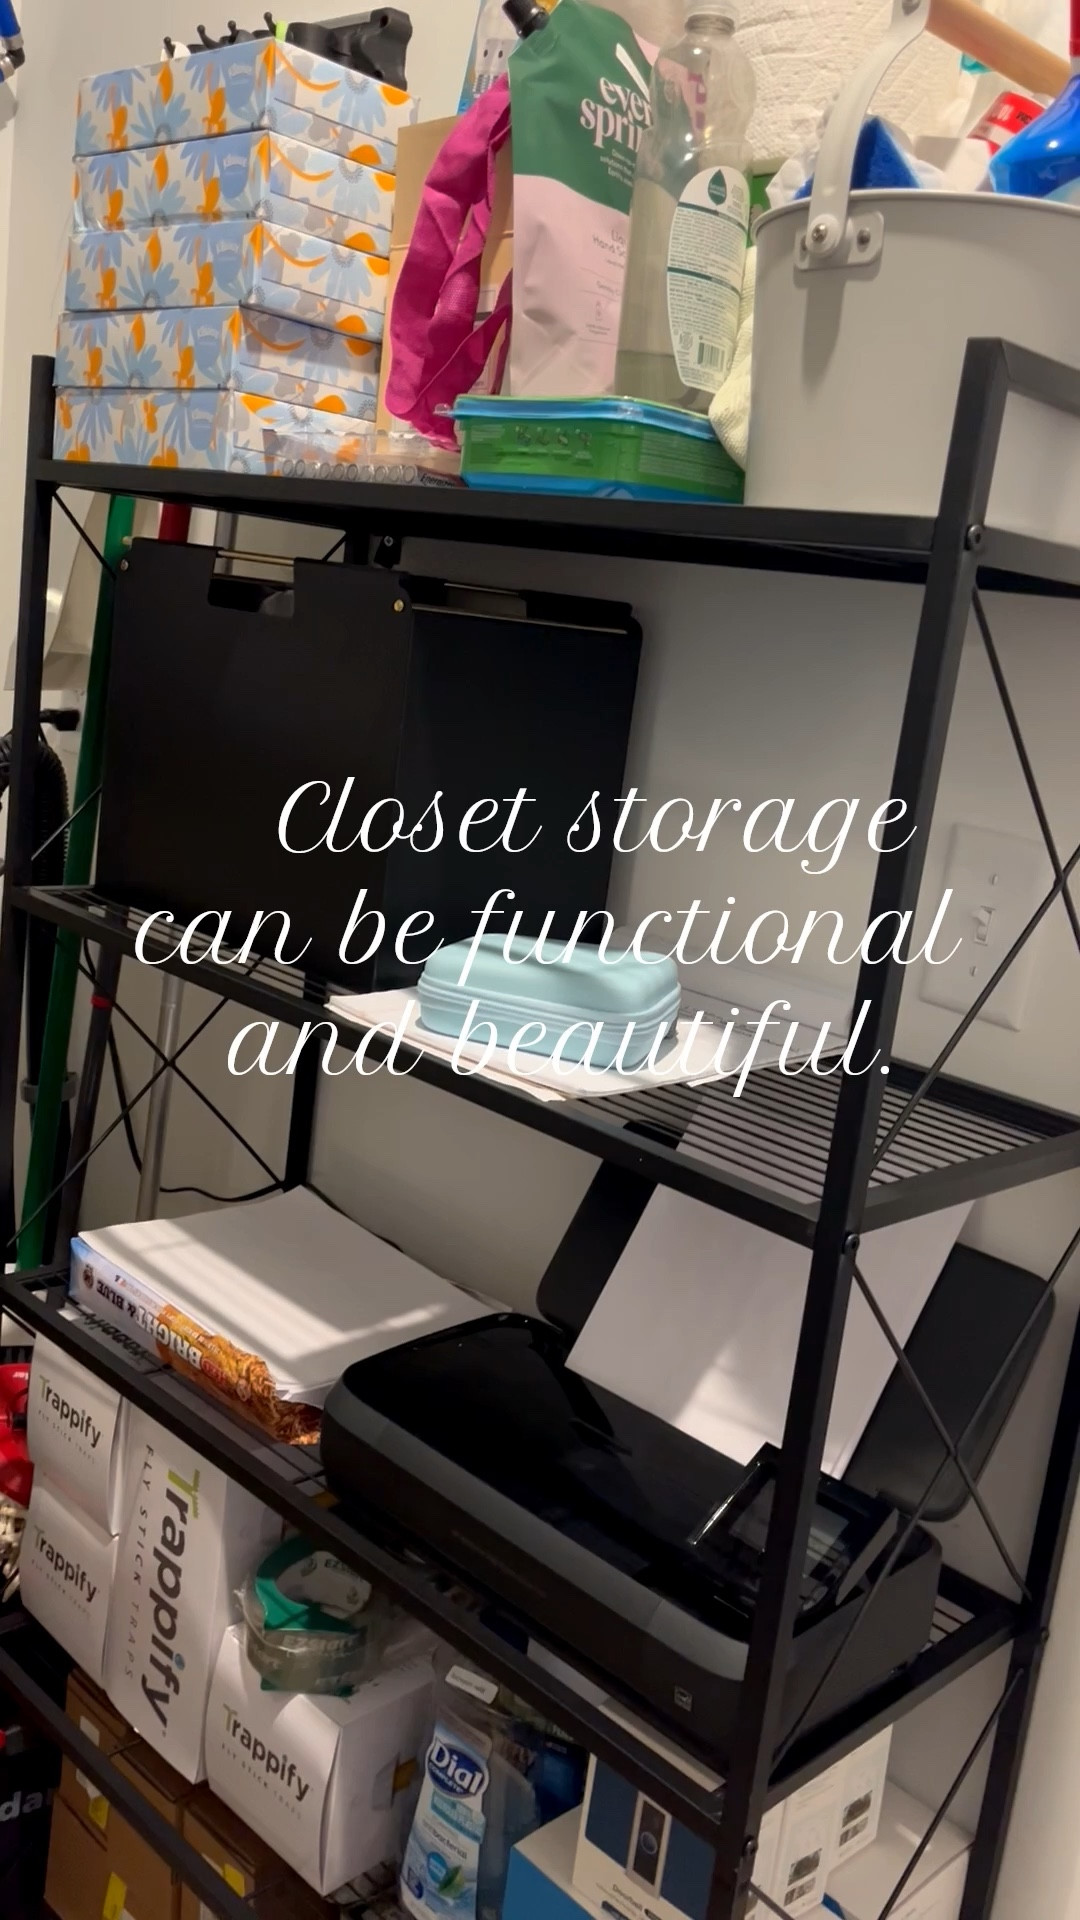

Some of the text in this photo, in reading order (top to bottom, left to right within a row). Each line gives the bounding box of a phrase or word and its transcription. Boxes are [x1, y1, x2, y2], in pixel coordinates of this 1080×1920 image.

[96, 1280, 125, 1311] BLUE
[127, 1302, 137, 1318] &
[136, 1305, 203, 1370] BRIGHT
[39, 1374, 102, 1449] Trappify
[33, 1524, 97, 1603] Trappify
[124, 1443, 155, 1680] FLY STICK TRAPS
[142, 1468, 201, 1730] Trappify
[222, 1702, 310, 1802] Trappify
[430, 1742, 484, 1794] Dial
